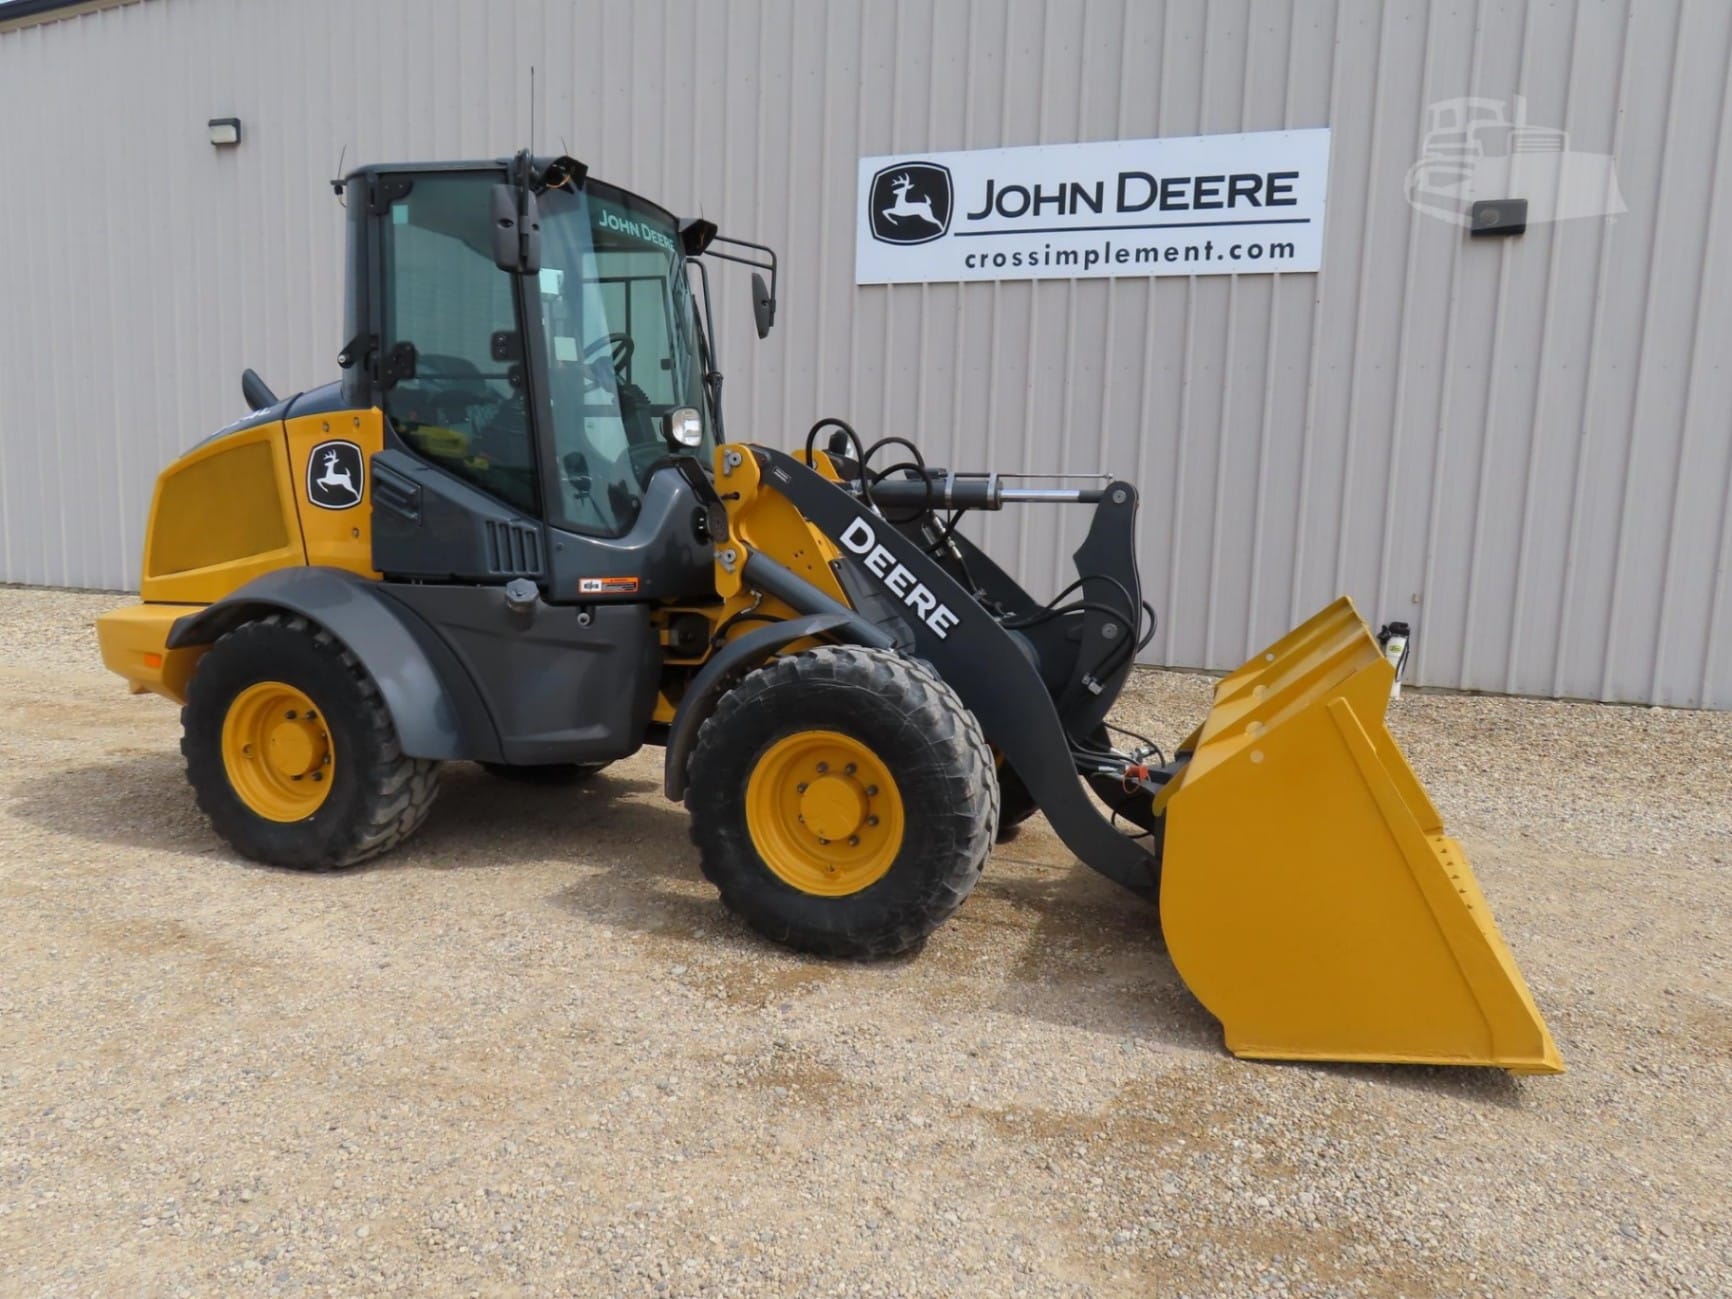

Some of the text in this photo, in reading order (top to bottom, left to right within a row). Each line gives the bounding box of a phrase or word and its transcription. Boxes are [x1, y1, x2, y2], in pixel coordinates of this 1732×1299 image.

[967, 171, 1300, 220] JOHN DEERE
[599, 209, 641, 238] JOHN
[965, 240, 1295, 270] crossimplement.com
[840, 516, 960, 639] DEERE
